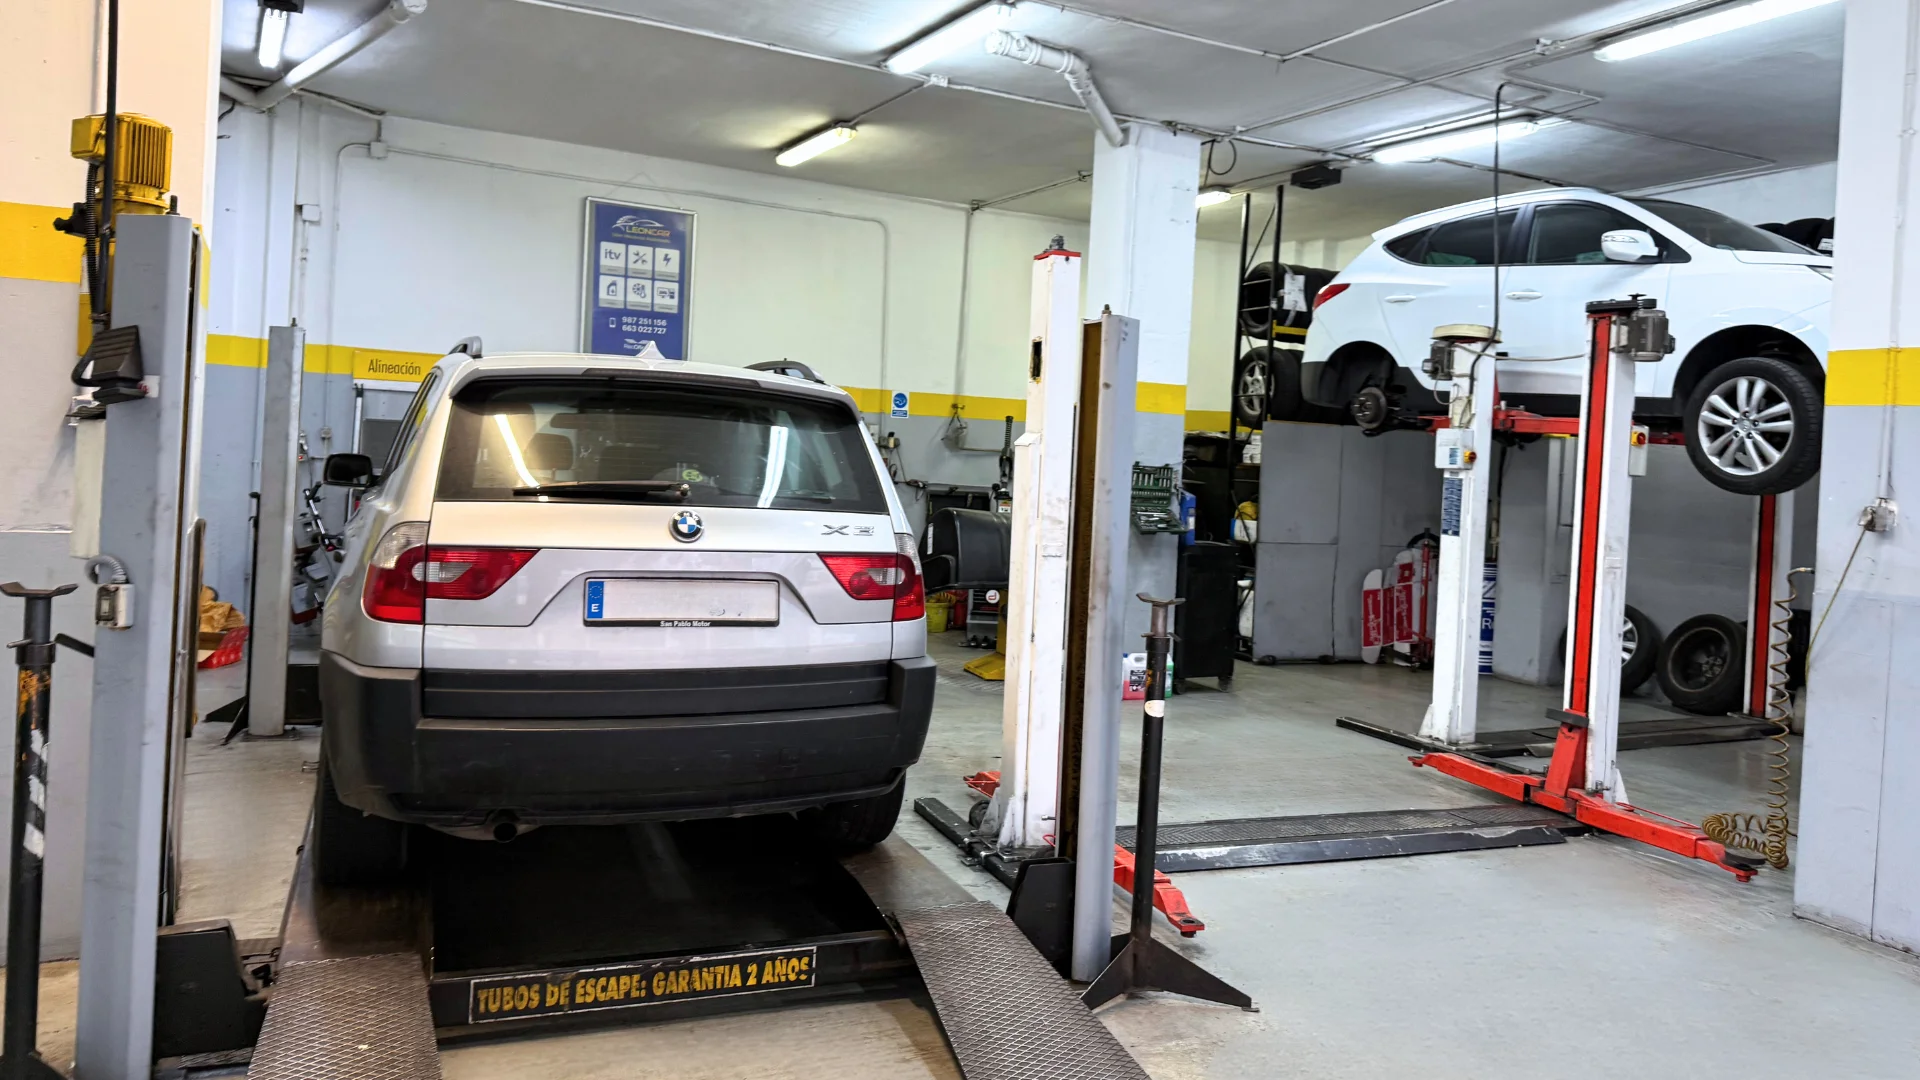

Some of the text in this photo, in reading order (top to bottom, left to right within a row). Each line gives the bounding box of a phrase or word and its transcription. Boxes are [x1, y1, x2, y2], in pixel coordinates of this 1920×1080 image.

[626, 225, 671, 237] LEONCAR
[604, 248, 622, 260] itv
[621, 316, 637, 324] 987
[638, 317, 652, 325] 251
[621, 324, 637, 332] 663
[637, 326, 652, 334] 022
[368, 358, 421, 375] Alineación
[591, 603, 600, 613] E
[477, 956, 810, 1014] TUBOS DE ESCAPE: GARANTIA 2 AÑOS
